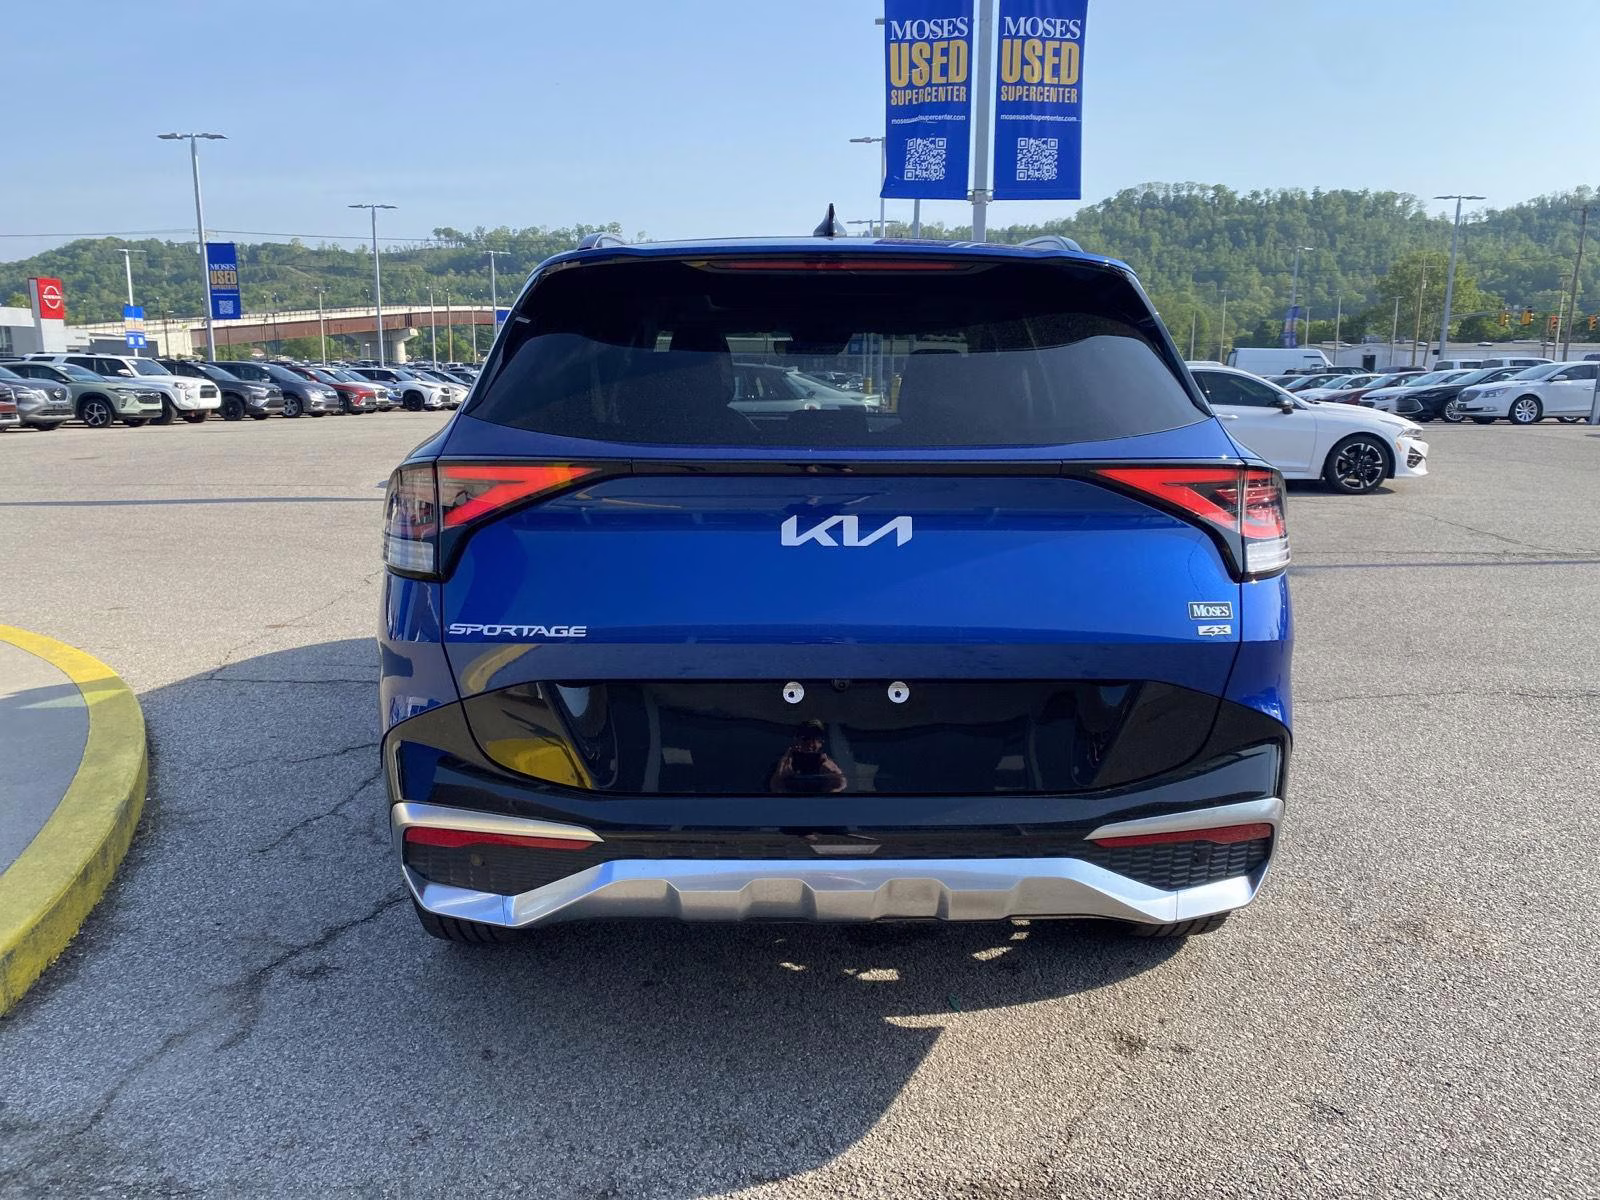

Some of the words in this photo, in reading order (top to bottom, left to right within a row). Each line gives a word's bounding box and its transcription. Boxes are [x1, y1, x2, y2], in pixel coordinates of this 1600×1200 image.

[890, 17, 968, 41] MOSES
[1003, 16, 1081, 39] MOSES
[889, 39, 968, 88] USED
[1001, 39, 1080, 85] USED
[890, 86, 967, 106] SUPERCENTER
[1001, 85, 1078, 104] SUPERCENTER
[209, 263, 236, 271] MOSES
[210, 270, 237, 285] USED
[449, 623, 587, 638] SPORTAGE
